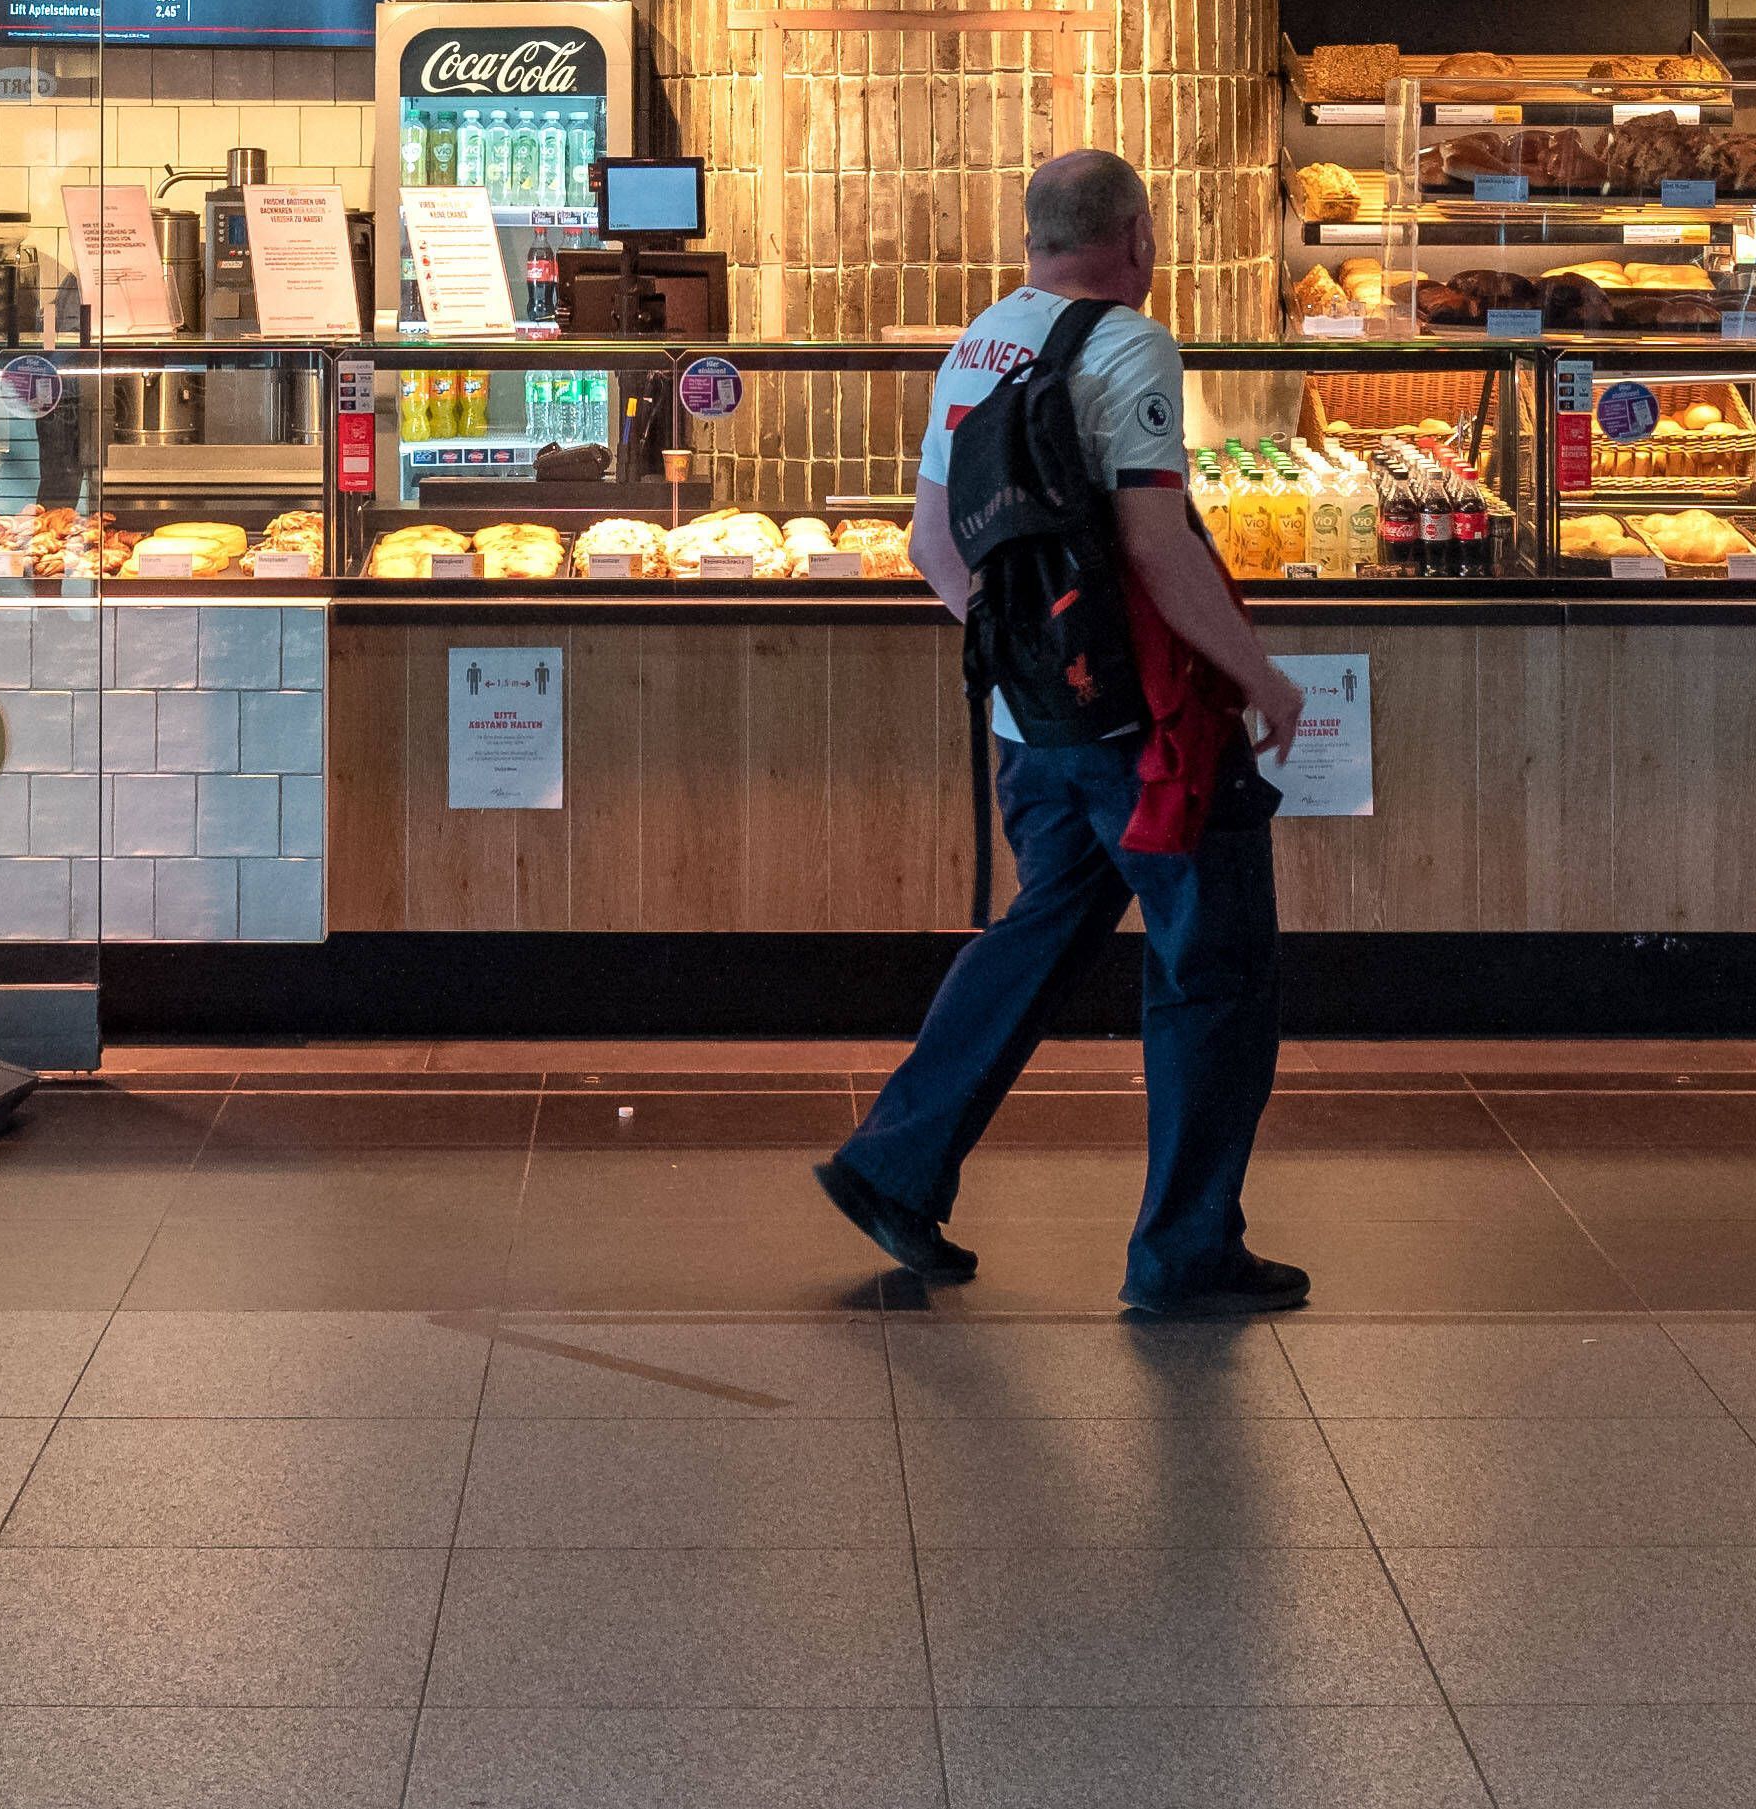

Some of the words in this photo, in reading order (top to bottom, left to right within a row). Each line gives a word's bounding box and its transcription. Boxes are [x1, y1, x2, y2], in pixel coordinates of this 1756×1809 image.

[10, 3, 27, 16] Lift
[28, 3, 89, 18] Apfelschorle
[420, 39, 587, 96] Coca-Cola
